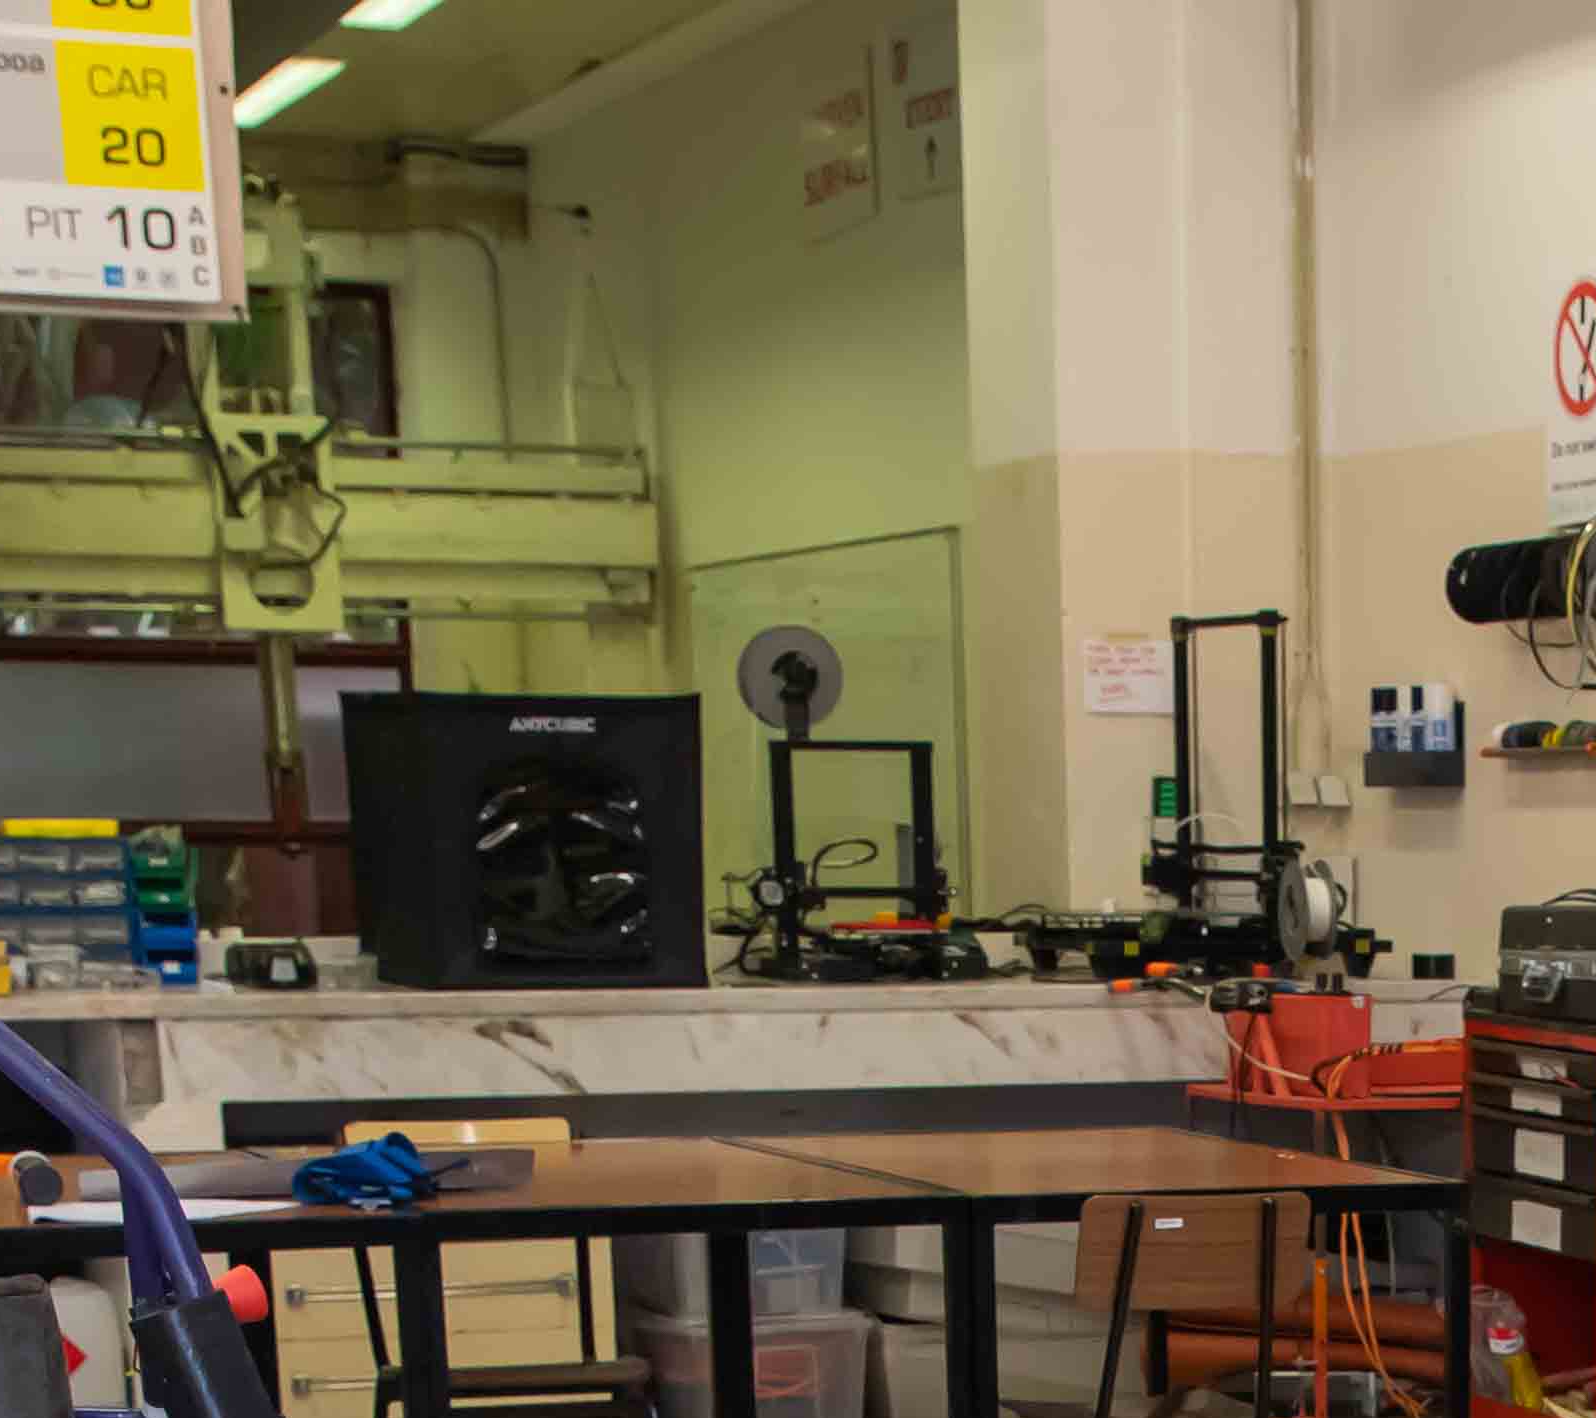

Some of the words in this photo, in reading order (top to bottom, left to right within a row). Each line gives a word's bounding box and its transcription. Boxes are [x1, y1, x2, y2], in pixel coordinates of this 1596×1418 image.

[86, 63, 169, 101] CAR
[100, 126, 167, 168] 20
[25, 206, 82, 241] PIT
[104, 205, 176, 251] 10
